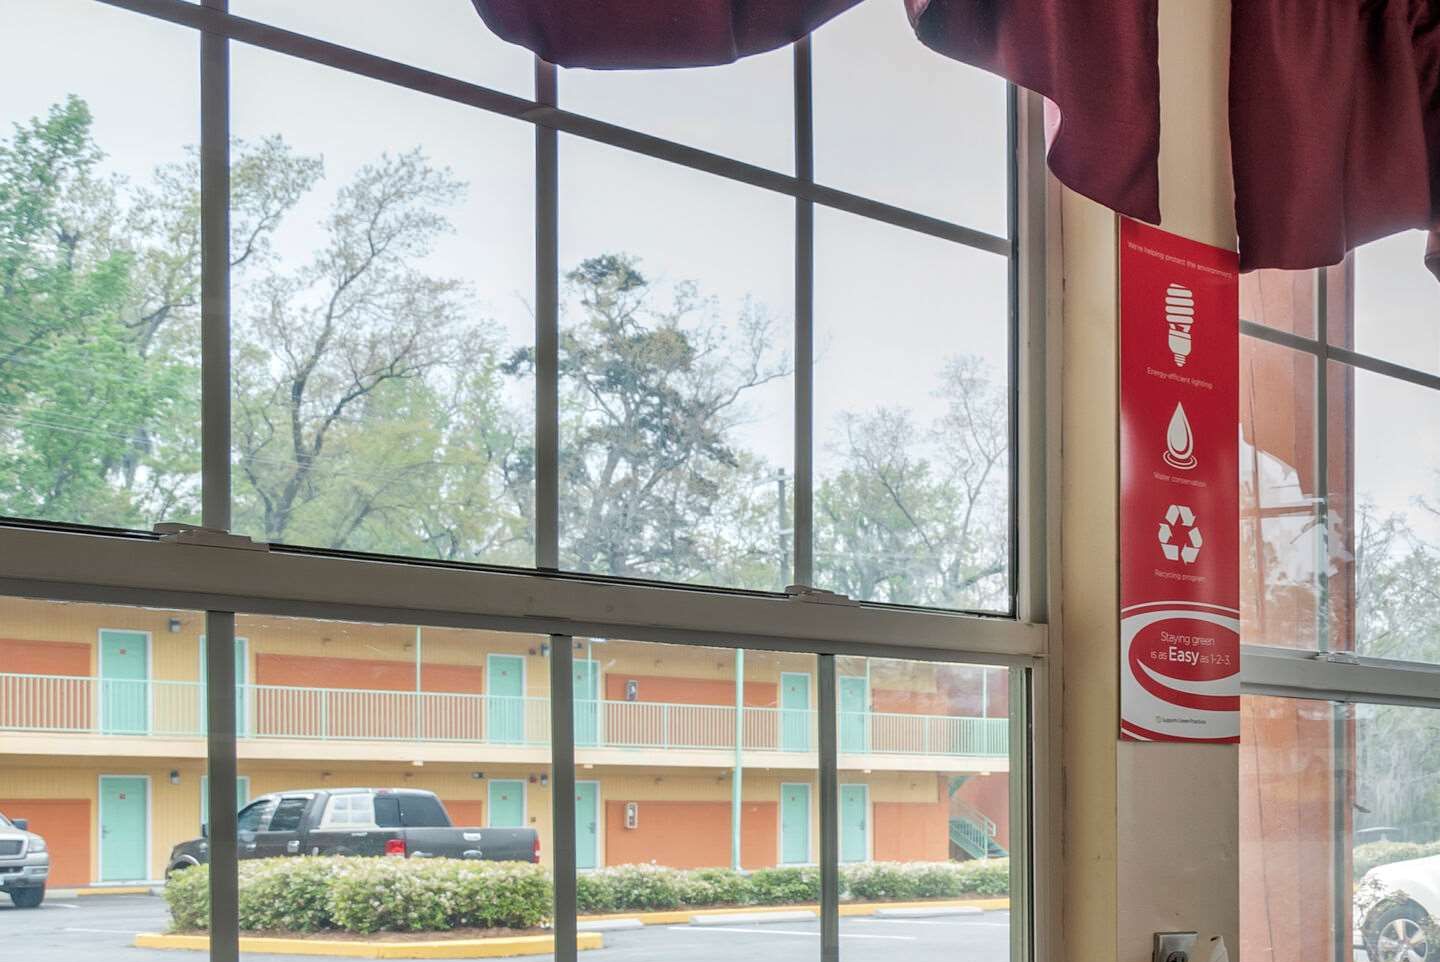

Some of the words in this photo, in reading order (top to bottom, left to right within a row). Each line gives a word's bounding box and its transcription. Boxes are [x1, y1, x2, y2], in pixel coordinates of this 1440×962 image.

[1160, 631, 1191, 646] Staying
[1191, 635, 1215, 647] green
[1168, 646, 1199, 666] Easy
